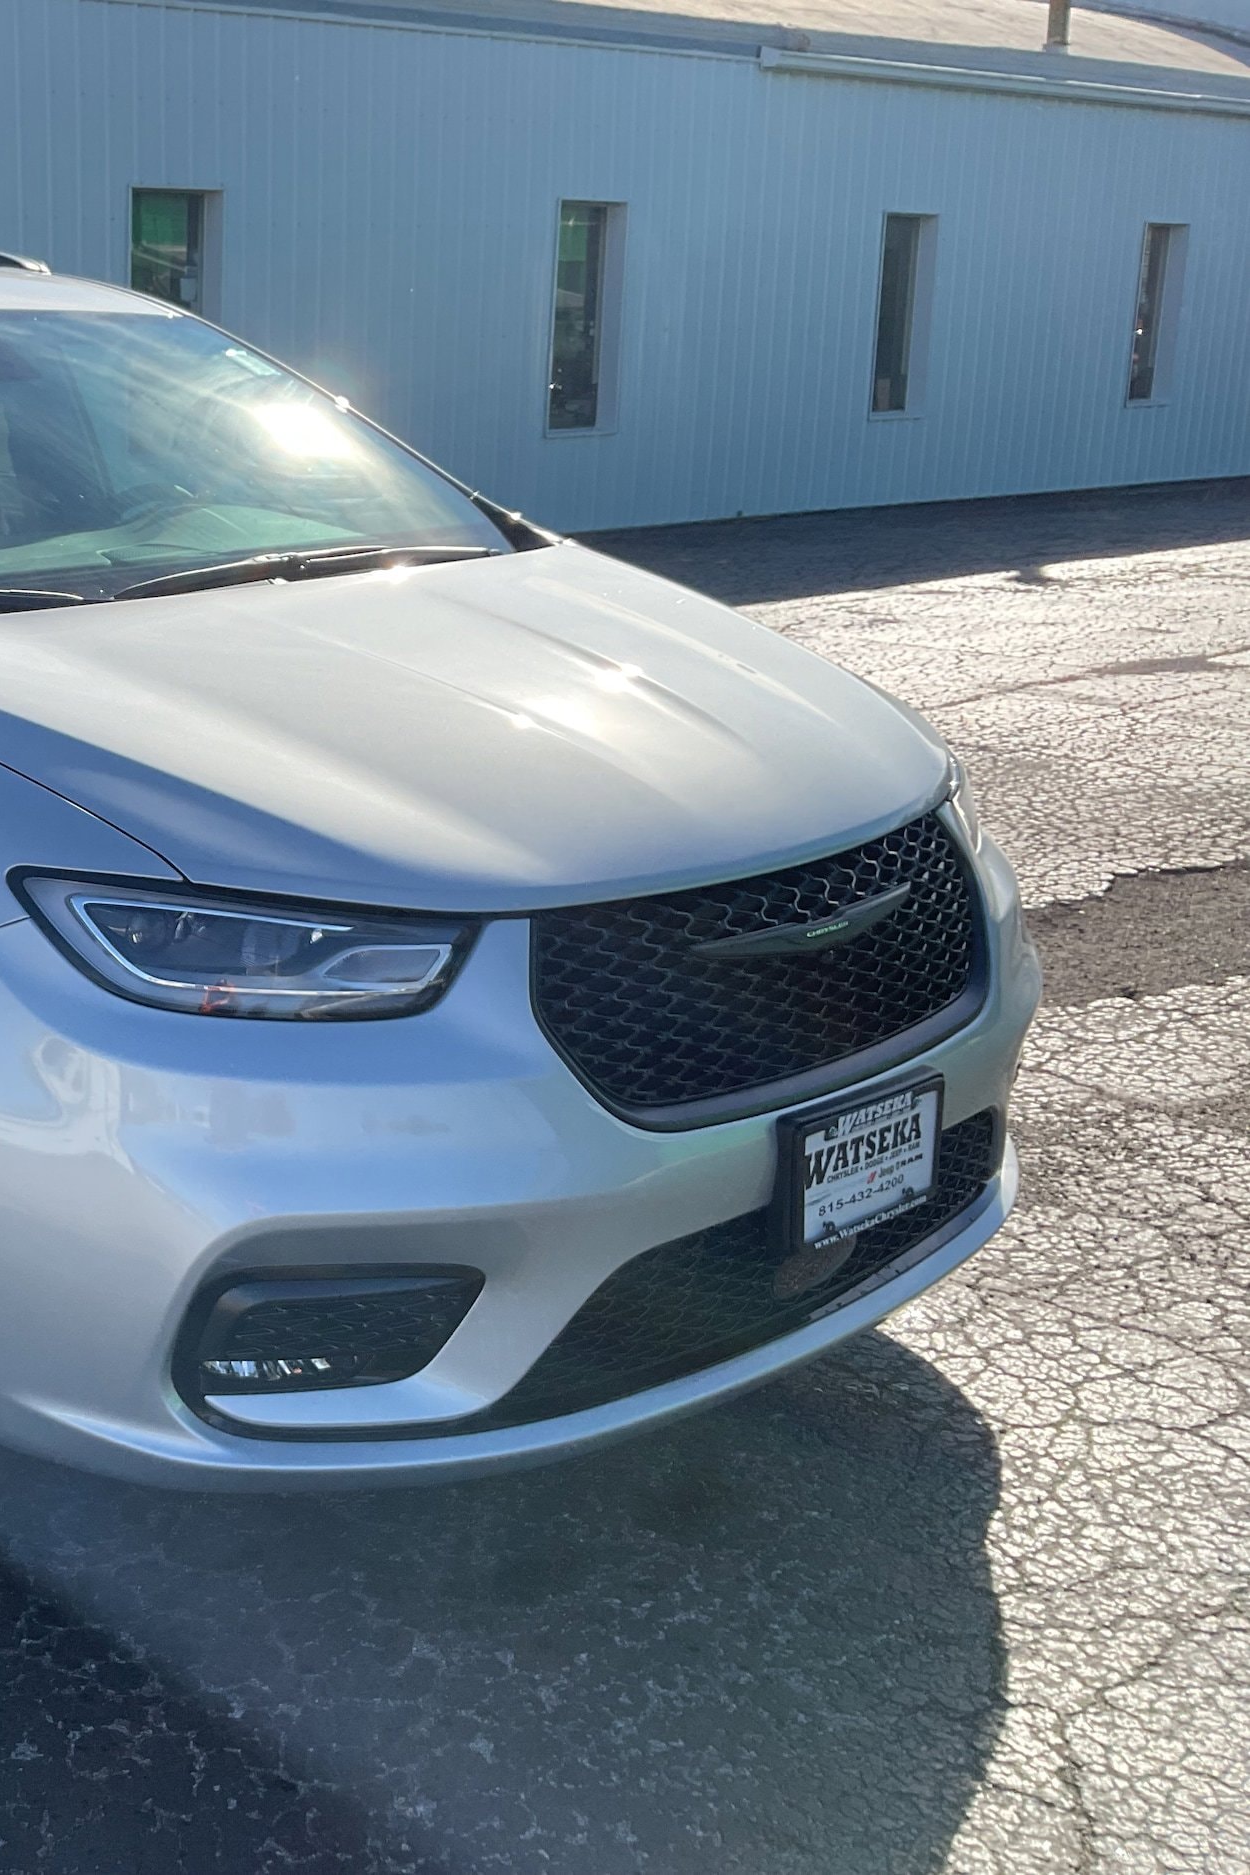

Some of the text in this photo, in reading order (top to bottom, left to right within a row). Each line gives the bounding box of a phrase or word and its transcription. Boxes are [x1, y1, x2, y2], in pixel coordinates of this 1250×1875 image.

[838, 1091, 913, 1137] WATSEKA
[803, 1113, 922, 1190] WATSEKA
[818, 1173, 905, 1217] 815-432-4200
